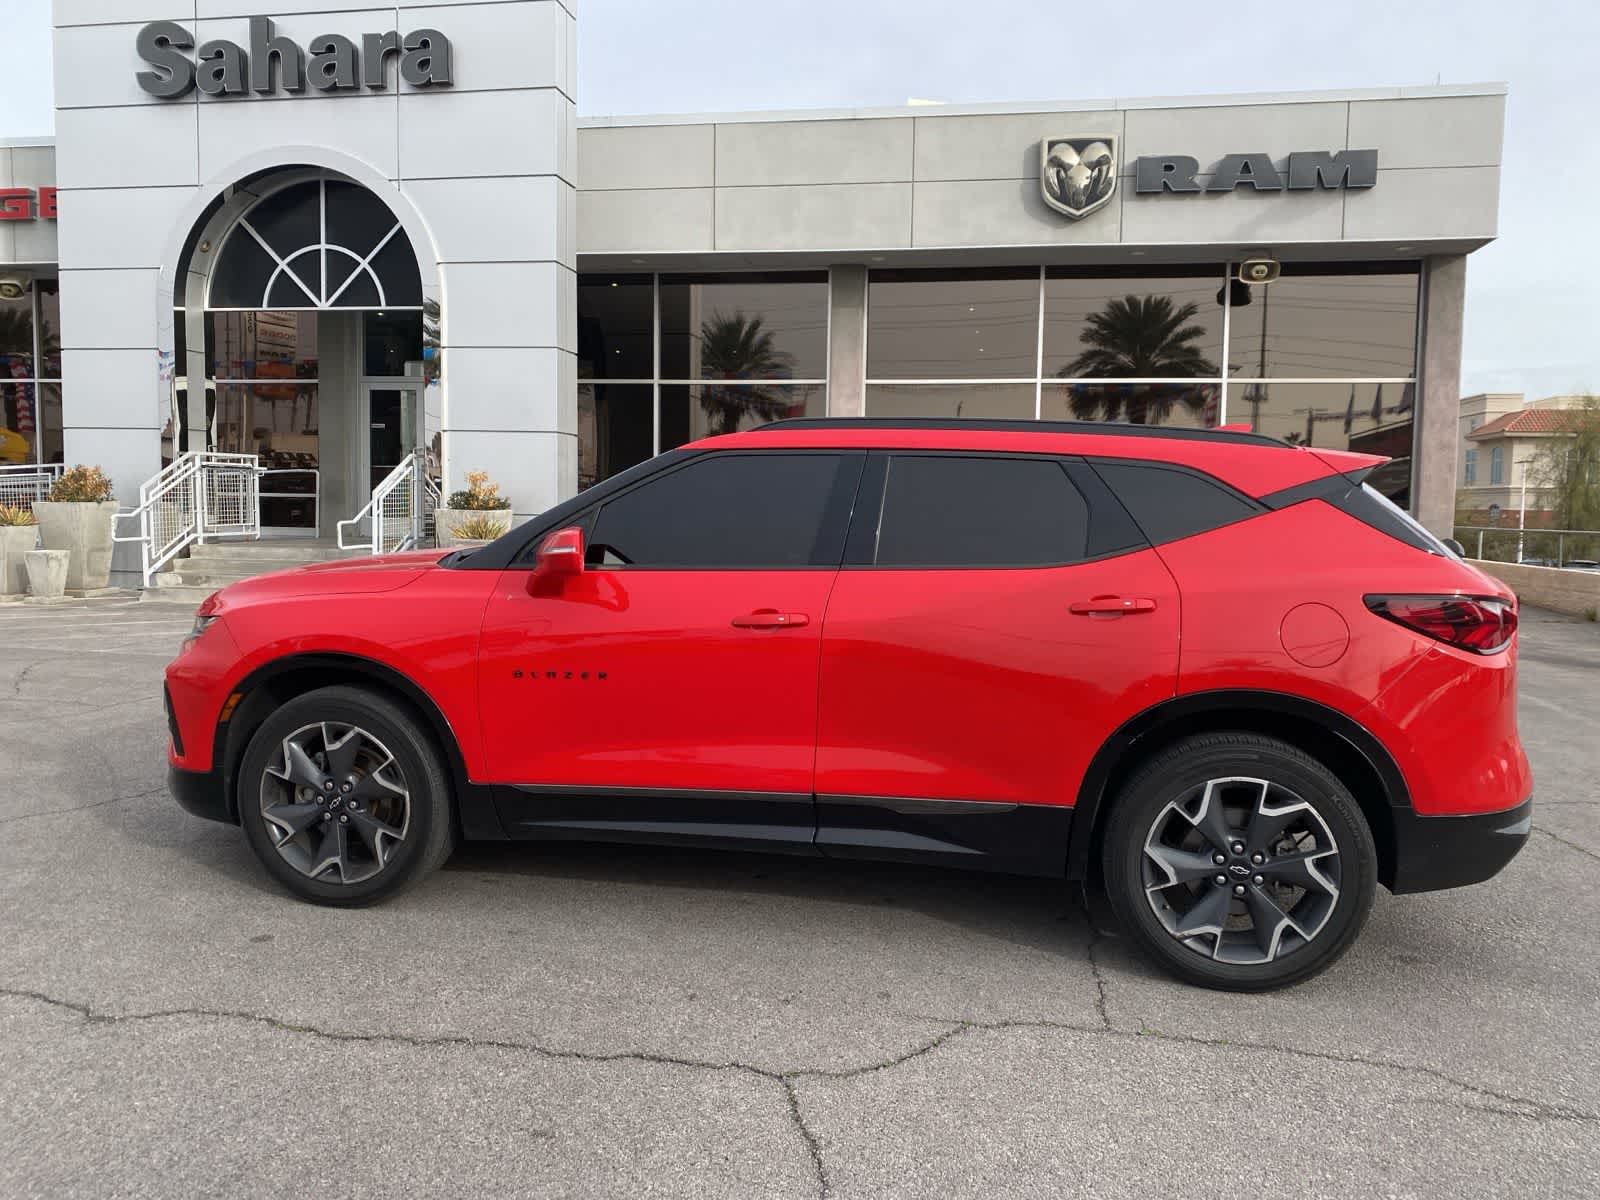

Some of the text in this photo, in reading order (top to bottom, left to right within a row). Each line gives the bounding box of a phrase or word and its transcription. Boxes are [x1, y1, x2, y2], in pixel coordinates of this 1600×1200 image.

[135, 15, 453, 98] Sahara
[1136, 149, 1379, 193] RAM
[512, 669, 608, 681] BLAZER
